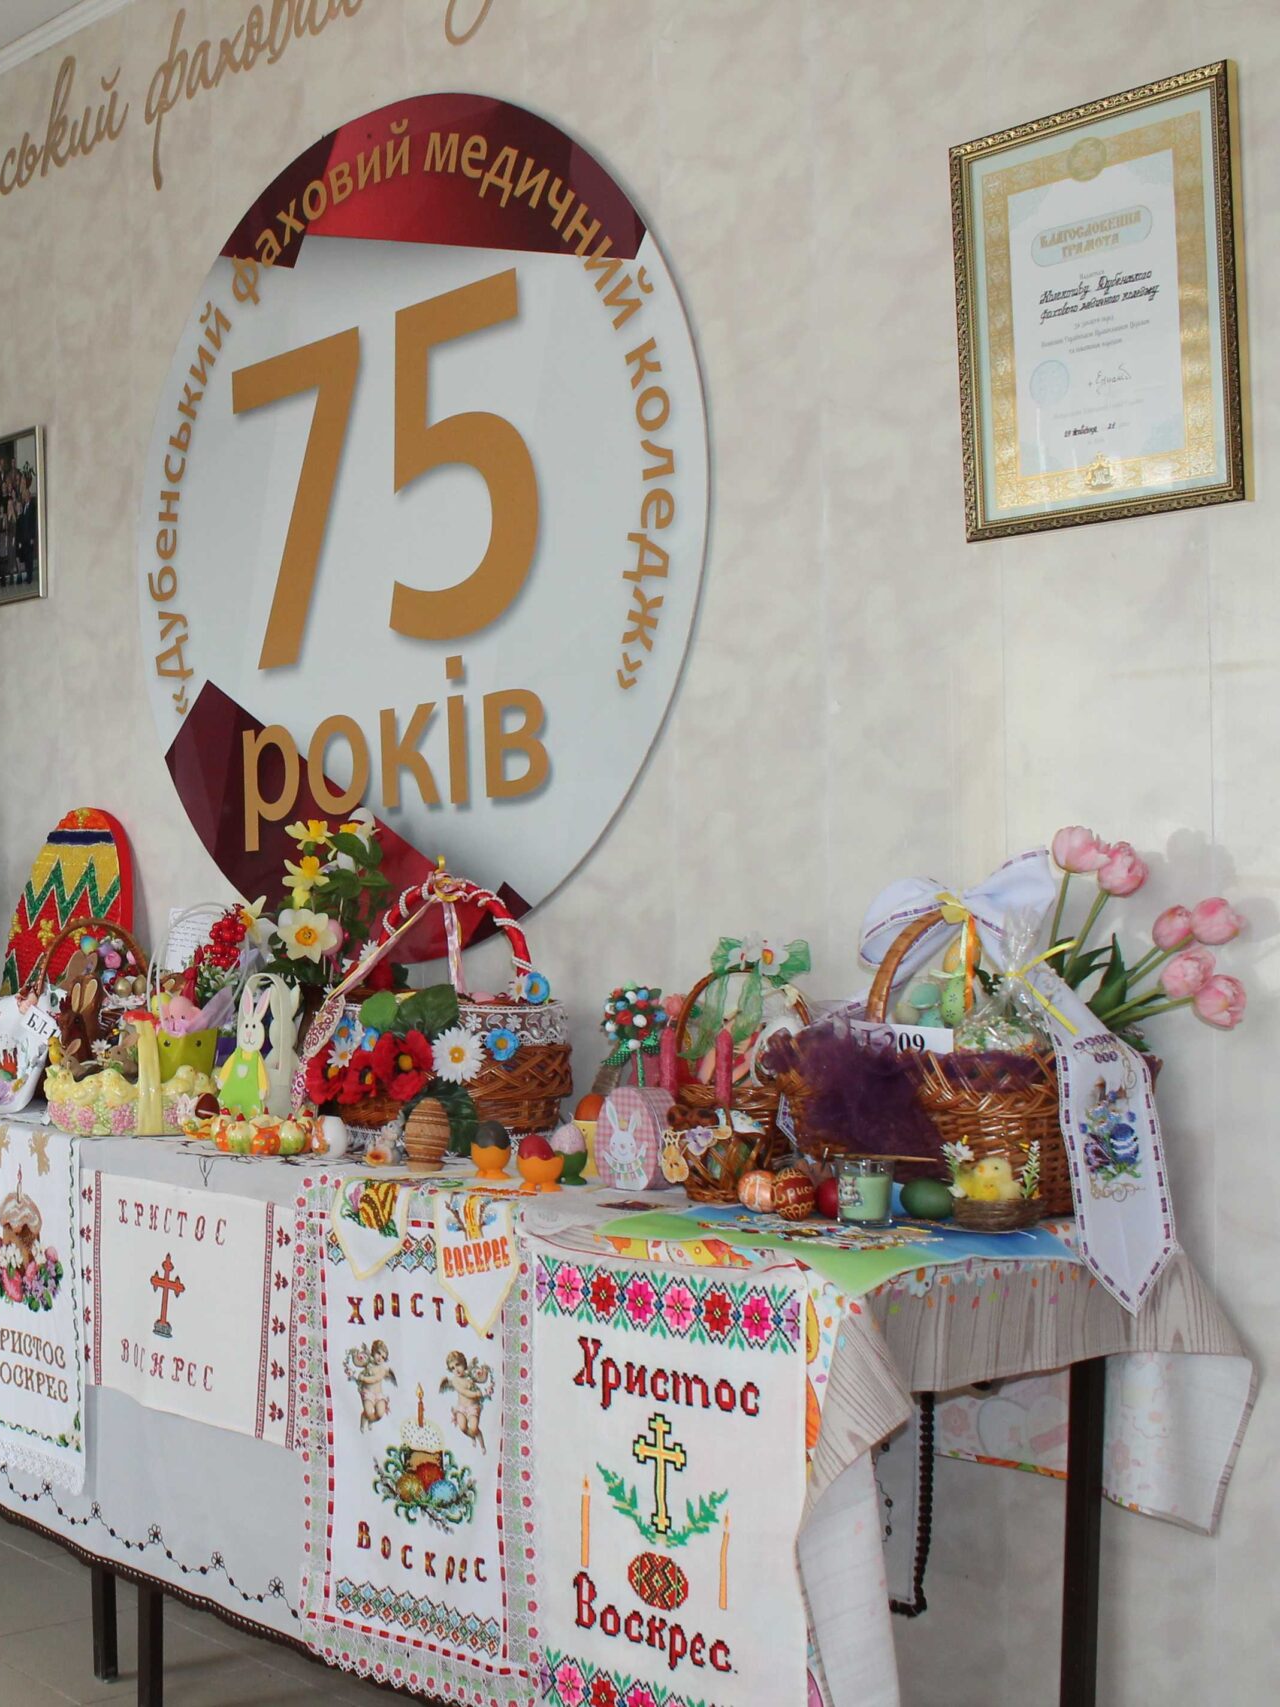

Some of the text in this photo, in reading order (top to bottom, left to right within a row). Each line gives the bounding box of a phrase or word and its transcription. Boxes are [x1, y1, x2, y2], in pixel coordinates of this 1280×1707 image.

[148, 119, 677, 716] «Дубенський фаховий медичний коледж»
[231, 266, 539, 671] 75
[240, 654, 551, 852] років
[117, 1198, 227, 1246] ХРИСТОС
[442, 1236, 511, 1279] ВОСКРЕС
[573, 1336, 761, 1417] Христос
